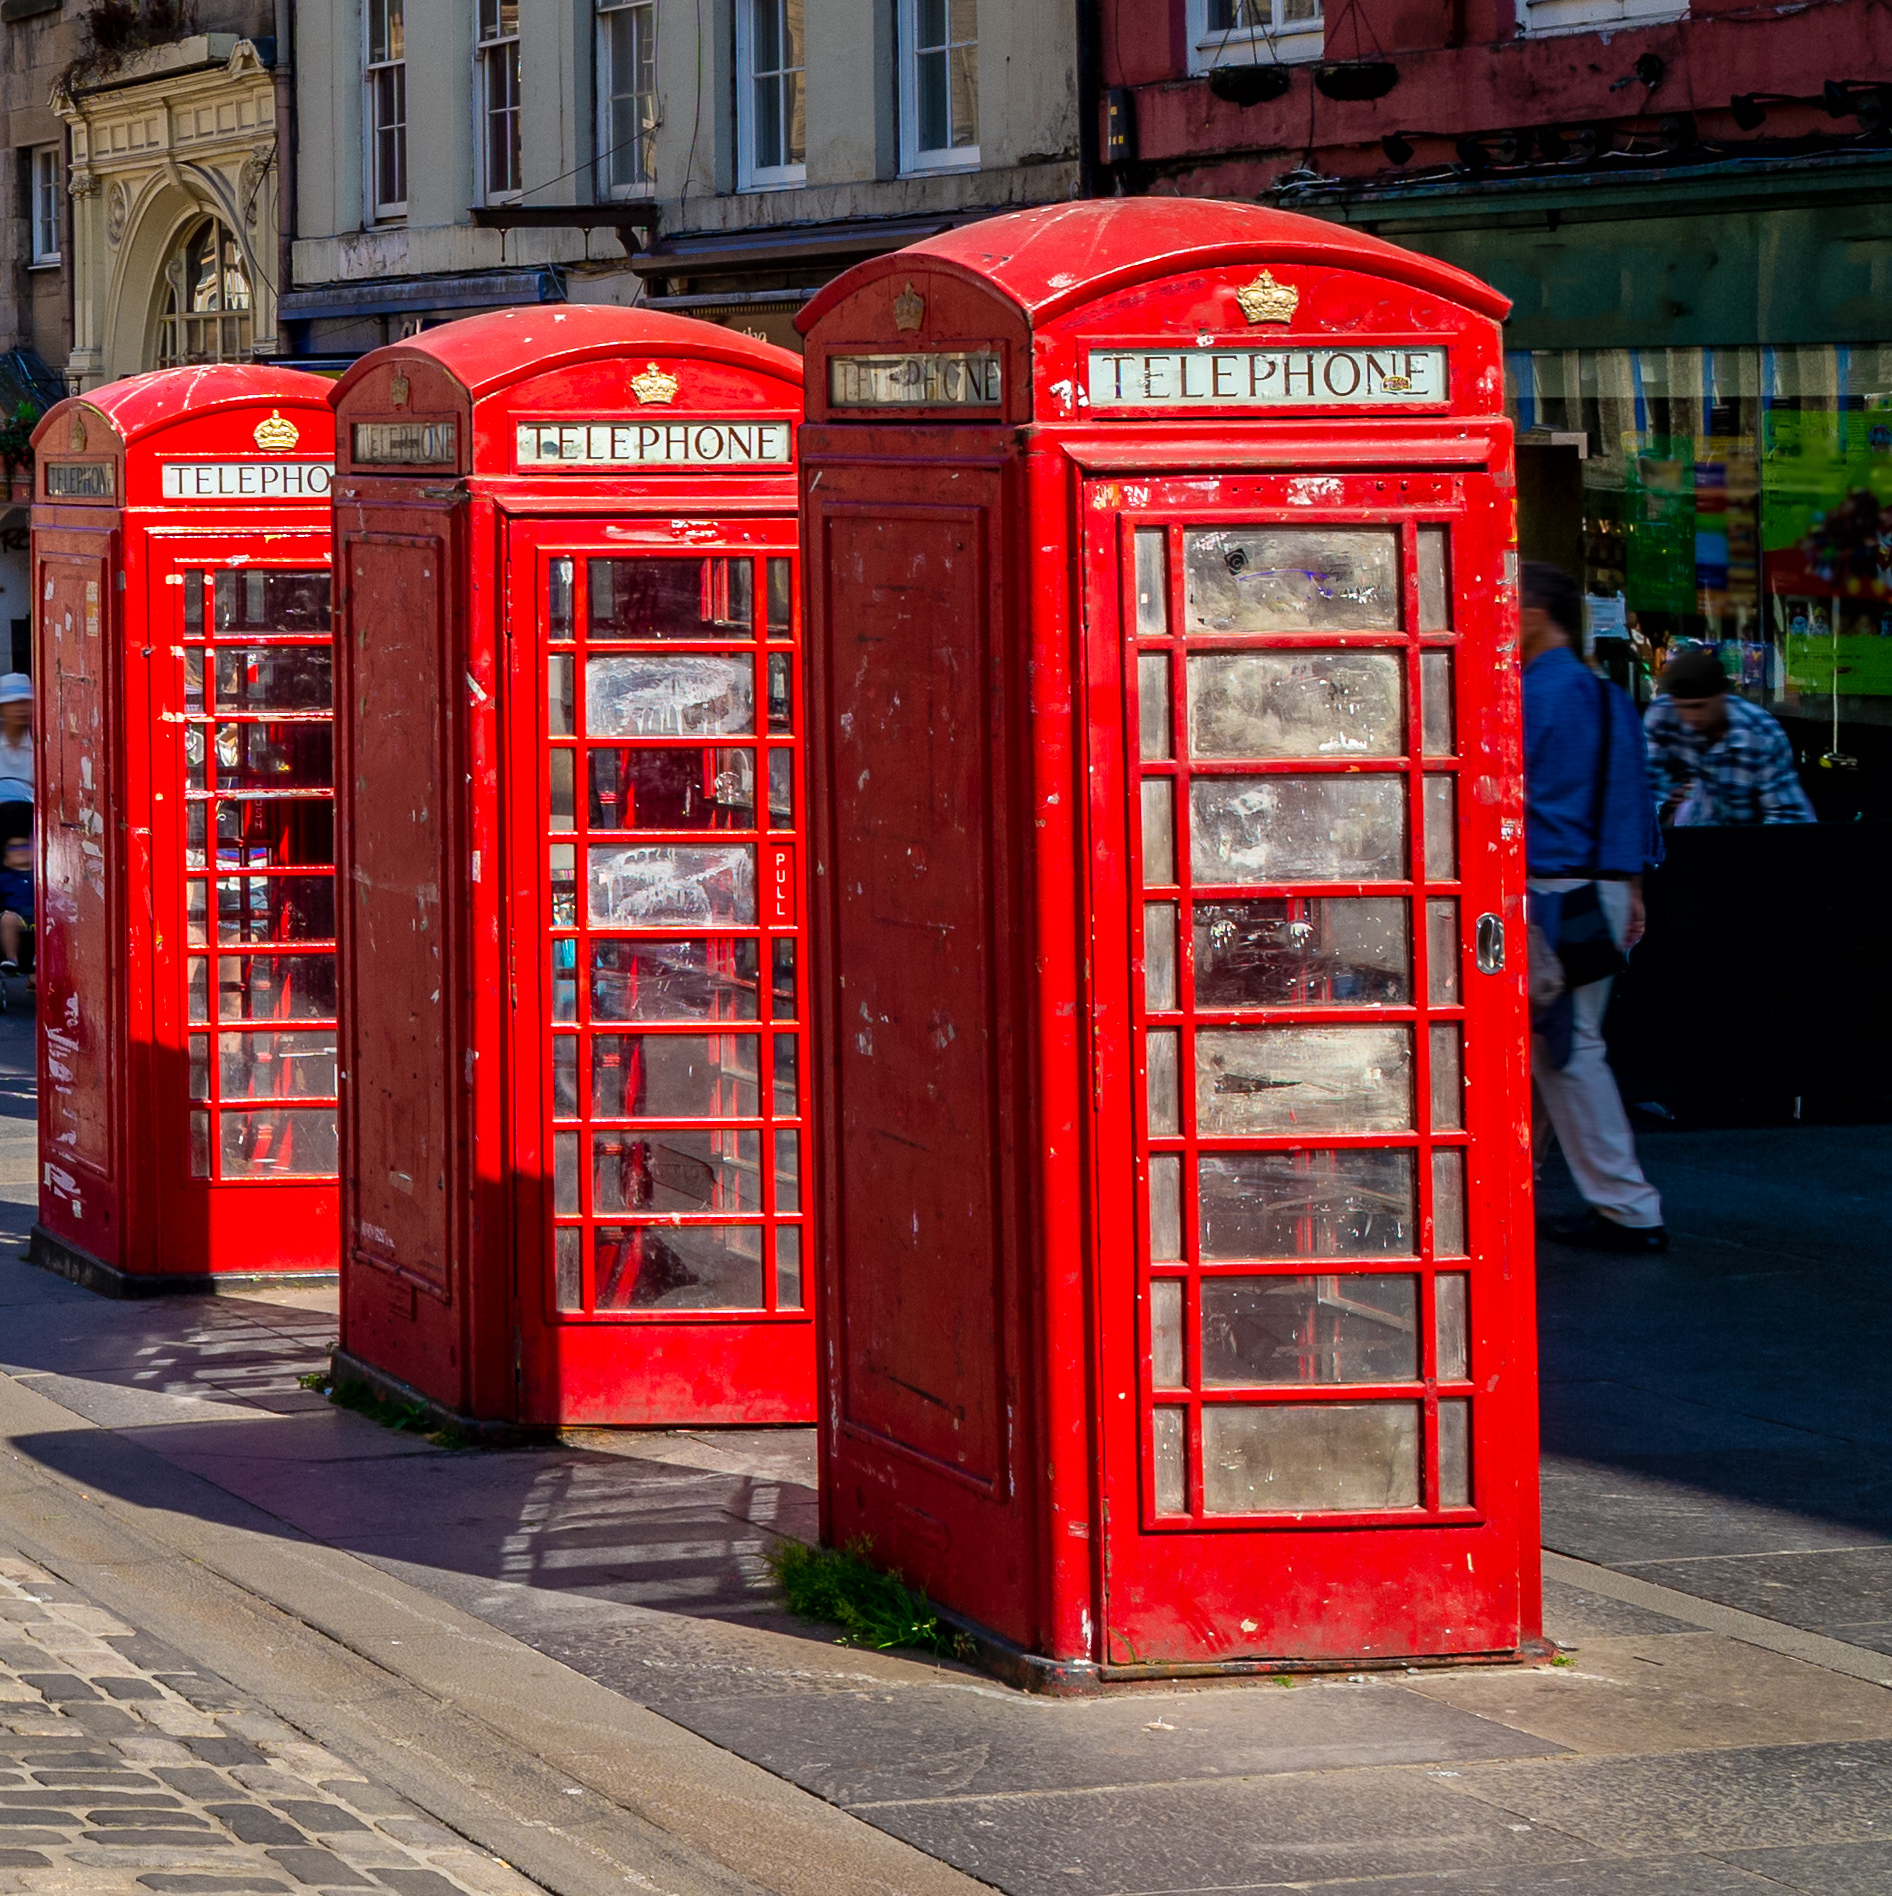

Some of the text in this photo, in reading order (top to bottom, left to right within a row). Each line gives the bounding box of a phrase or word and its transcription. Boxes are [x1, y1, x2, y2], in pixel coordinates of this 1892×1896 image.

[1102, 352, 1430, 400] TELEPHONE
[526, 425, 778, 460] TELEPHONE
[170, 465, 332, 495] TELEPHO
[775, 852, 786, 916] PULL
